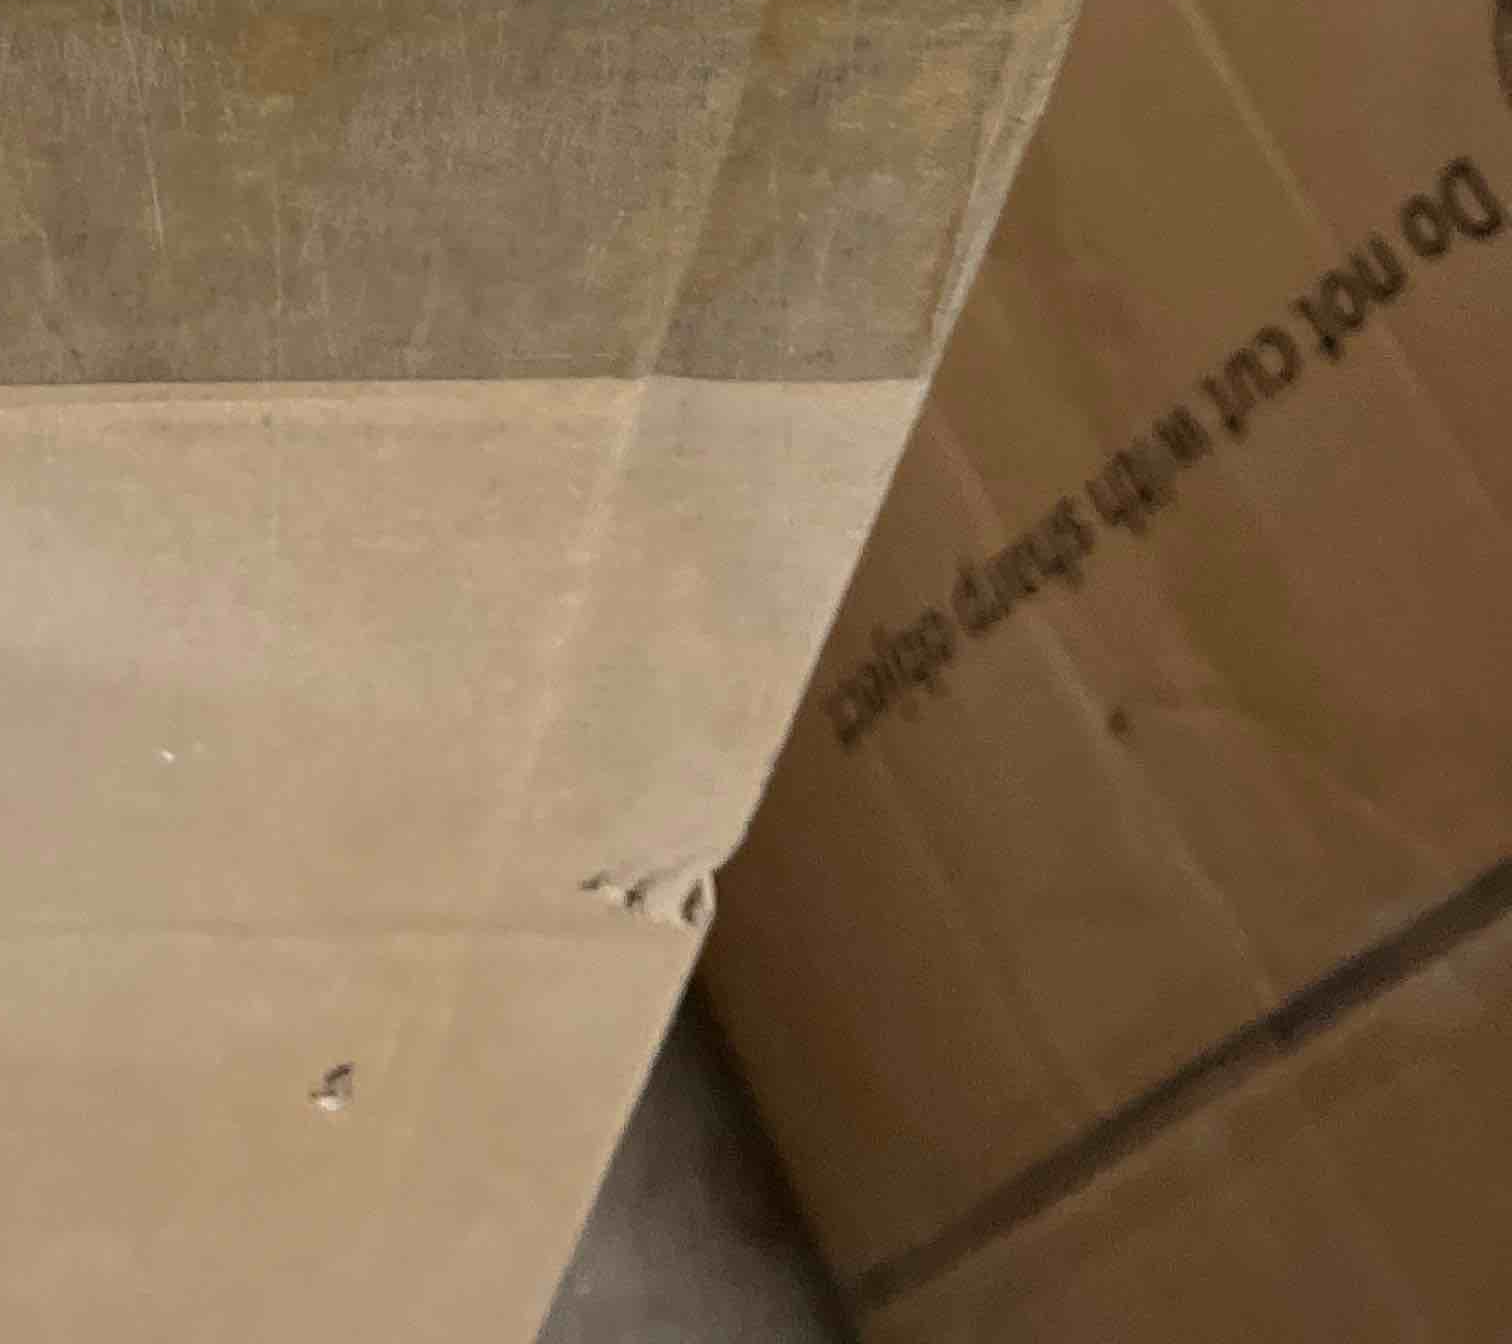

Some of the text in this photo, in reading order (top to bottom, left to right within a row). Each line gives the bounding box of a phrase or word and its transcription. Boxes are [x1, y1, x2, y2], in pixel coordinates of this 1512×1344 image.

[1398, 156, 1503, 261] Do
[1290, 233, 1407, 363] not
[1199, 323, 1303, 443] cut
[1085, 402, 1214, 538] with
[949, 494, 1096, 639] sharp
